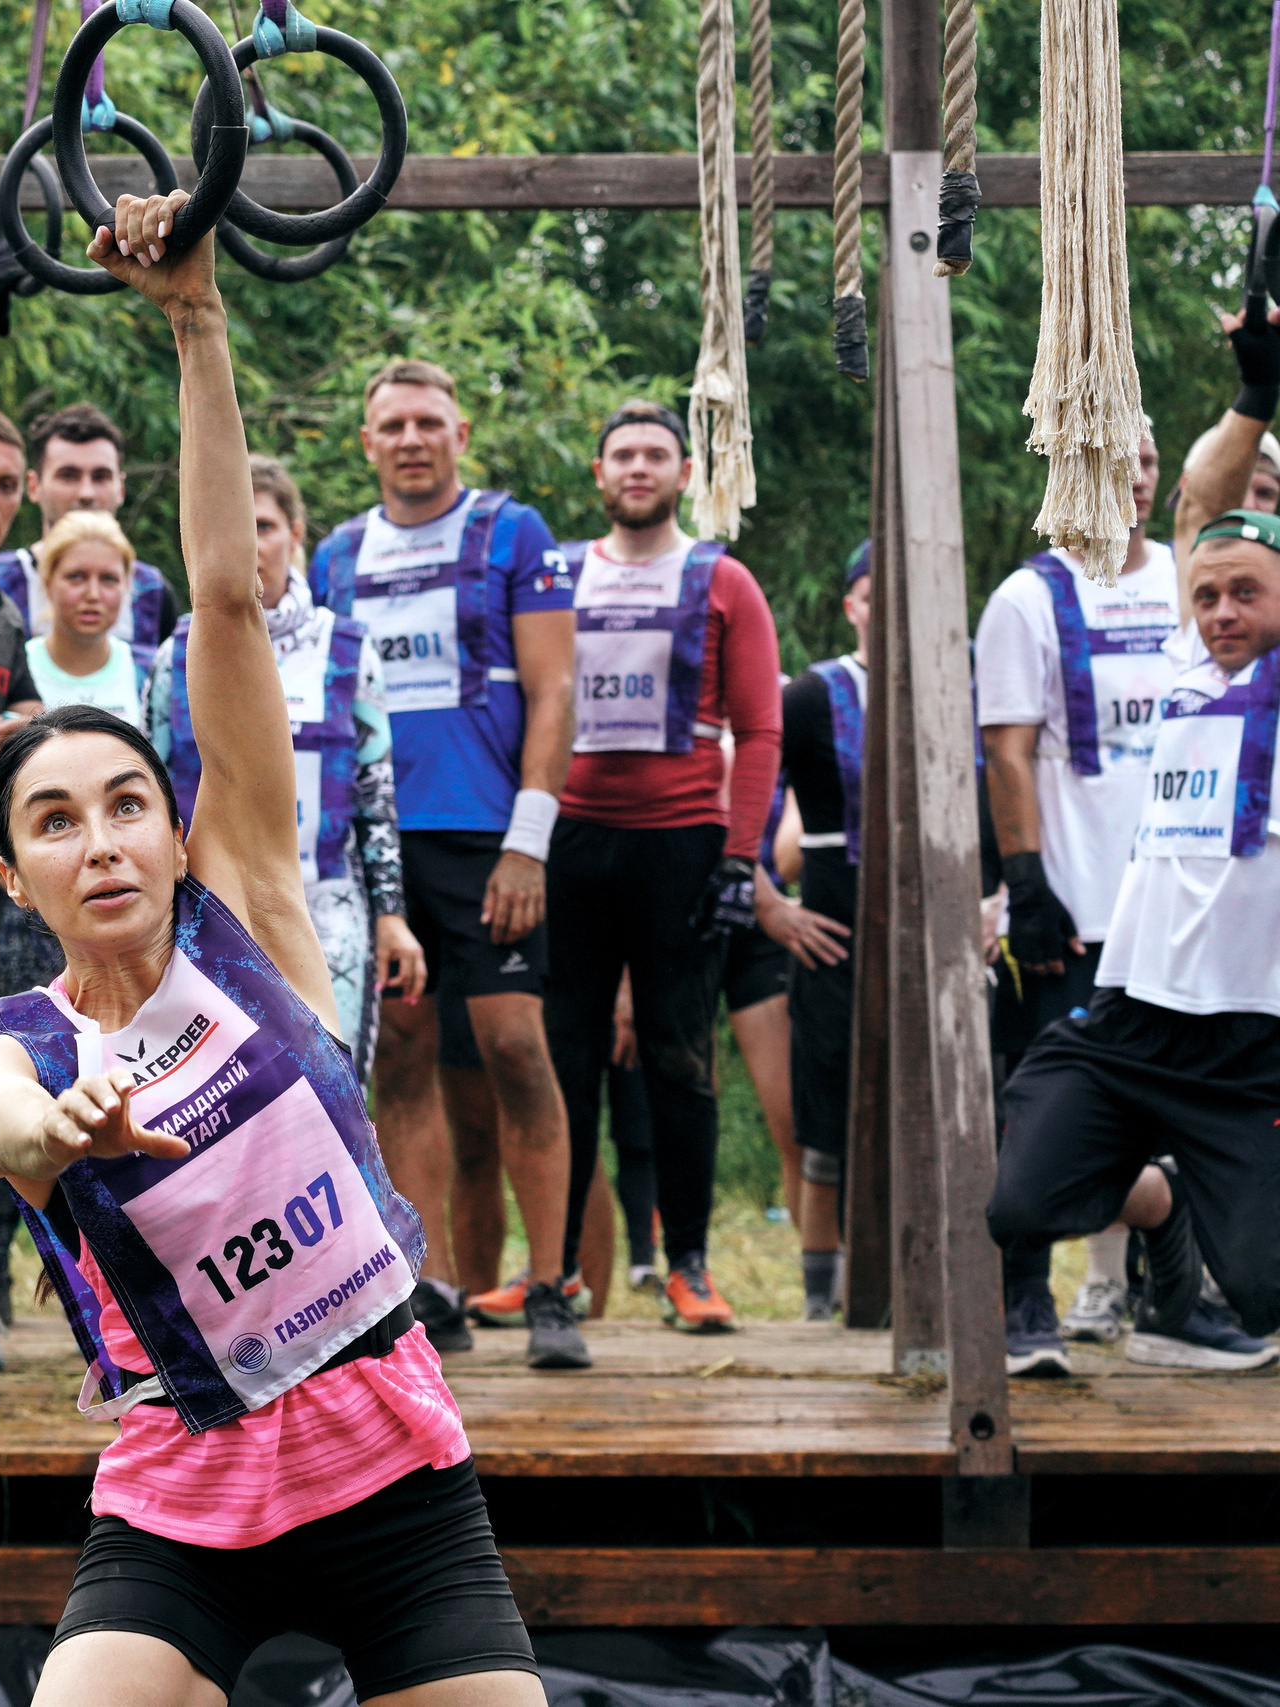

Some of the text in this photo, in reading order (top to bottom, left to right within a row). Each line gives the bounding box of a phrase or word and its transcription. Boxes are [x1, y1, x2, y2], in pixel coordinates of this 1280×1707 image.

[583, 673, 655, 700] 12308
[1154, 769, 1219, 802] 10701
[145, 1013, 210, 1078] ГЕРОЕВ
[134, 1055, 250, 1158] МАНДНЫЙ
[180, 1102, 232, 1148] ТАРТ
[196, 1171, 344, 1304] 12307
[274, 1244, 397, 1344] ГАЗПРОМБАНК
